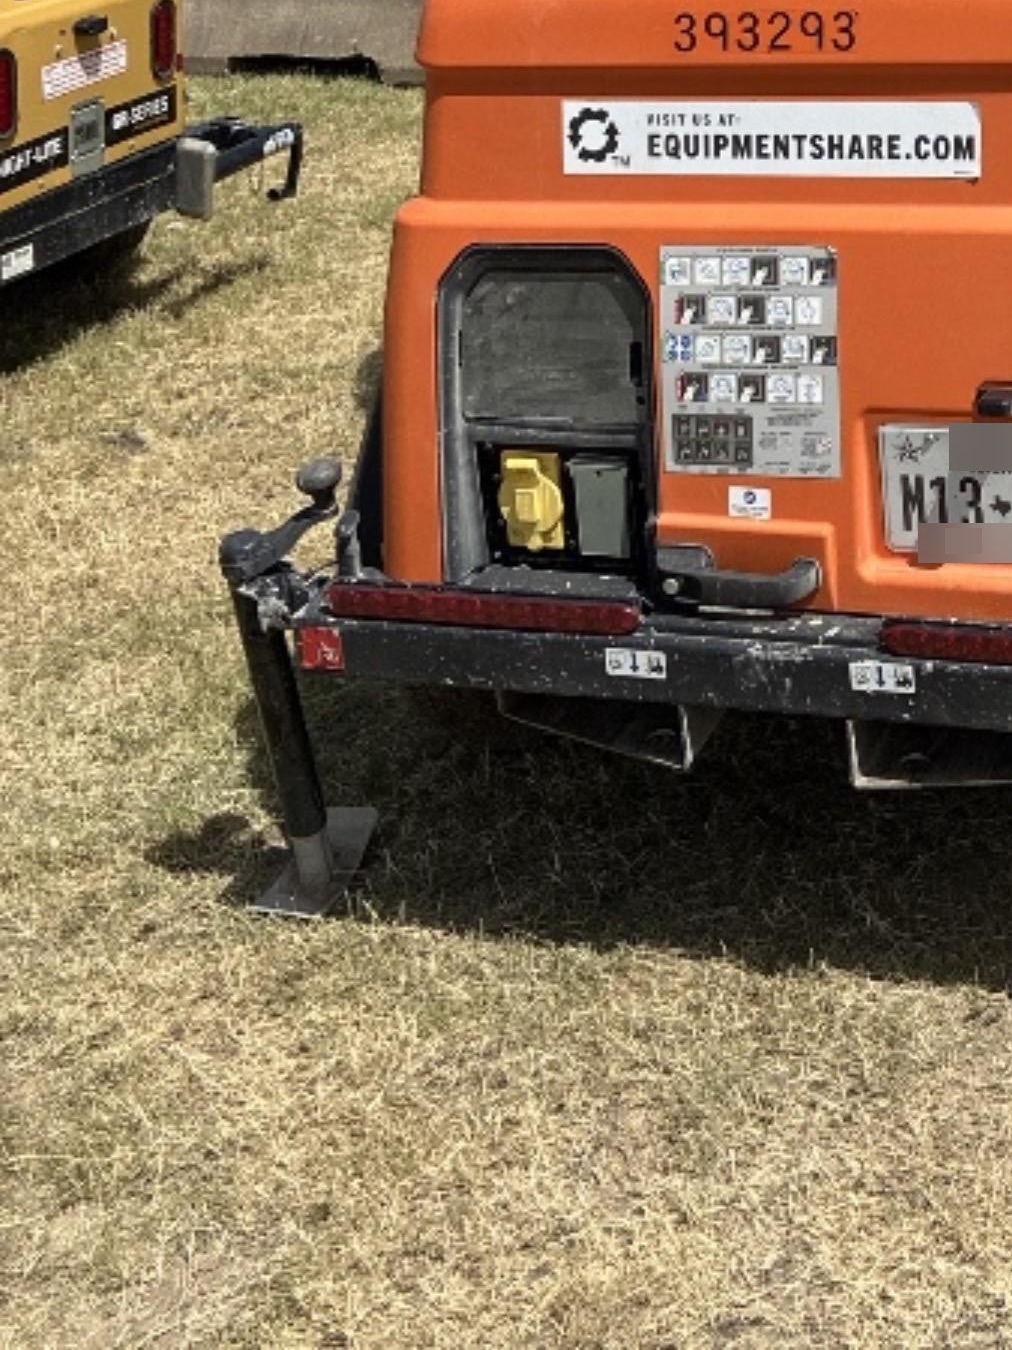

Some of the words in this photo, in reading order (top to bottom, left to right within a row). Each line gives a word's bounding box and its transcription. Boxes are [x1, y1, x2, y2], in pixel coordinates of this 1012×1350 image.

[674, 11, 859, 52] 393293
[647, 113, 686, 127] VISIT
[691, 113, 712, 127] US
[647, 134, 976, 161] EQUIPMENTSHARE.COM
